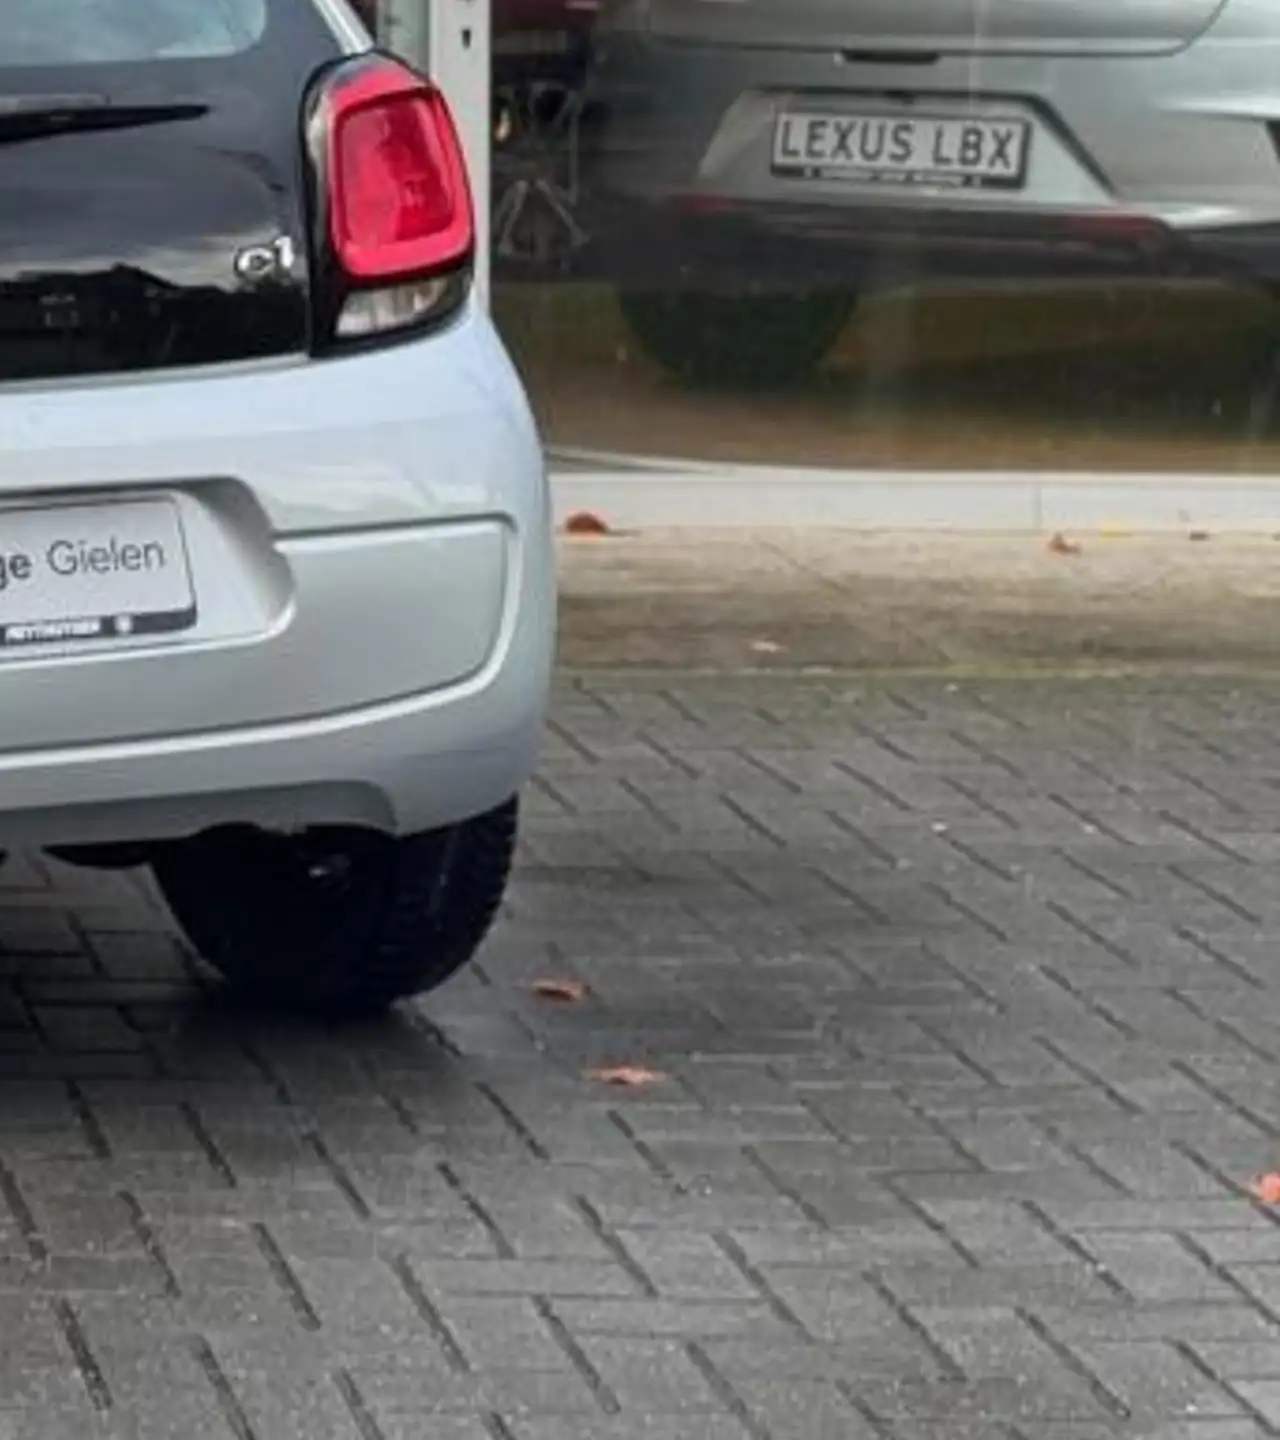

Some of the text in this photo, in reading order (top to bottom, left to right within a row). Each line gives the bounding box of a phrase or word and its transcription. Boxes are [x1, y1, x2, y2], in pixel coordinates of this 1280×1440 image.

[780, 118, 1014, 170] LEXUS LBX
[46, 536, 166, 576] Gielen
